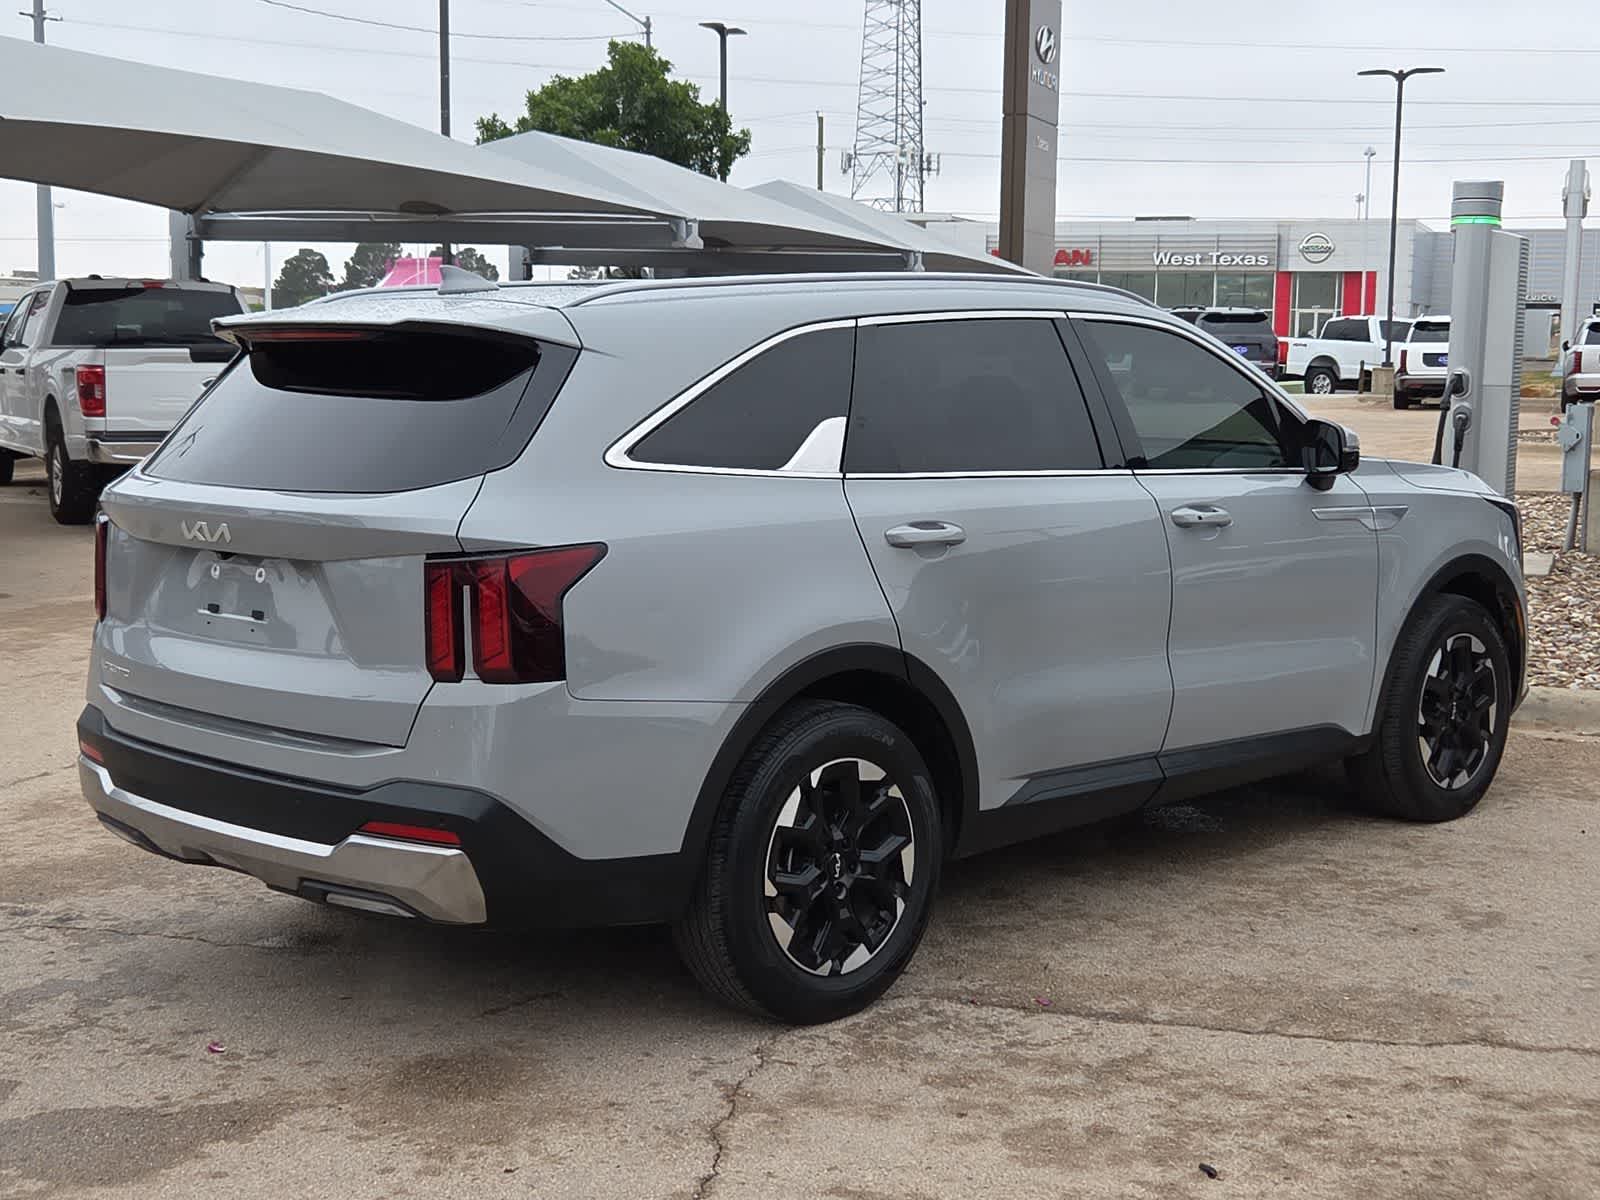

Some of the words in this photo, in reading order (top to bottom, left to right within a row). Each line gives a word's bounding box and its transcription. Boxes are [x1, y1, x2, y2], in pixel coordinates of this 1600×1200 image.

[1152, 251, 1202, 266] West
[1208, 251, 1269, 266] Texas
[181, 520, 232, 543] KIA
